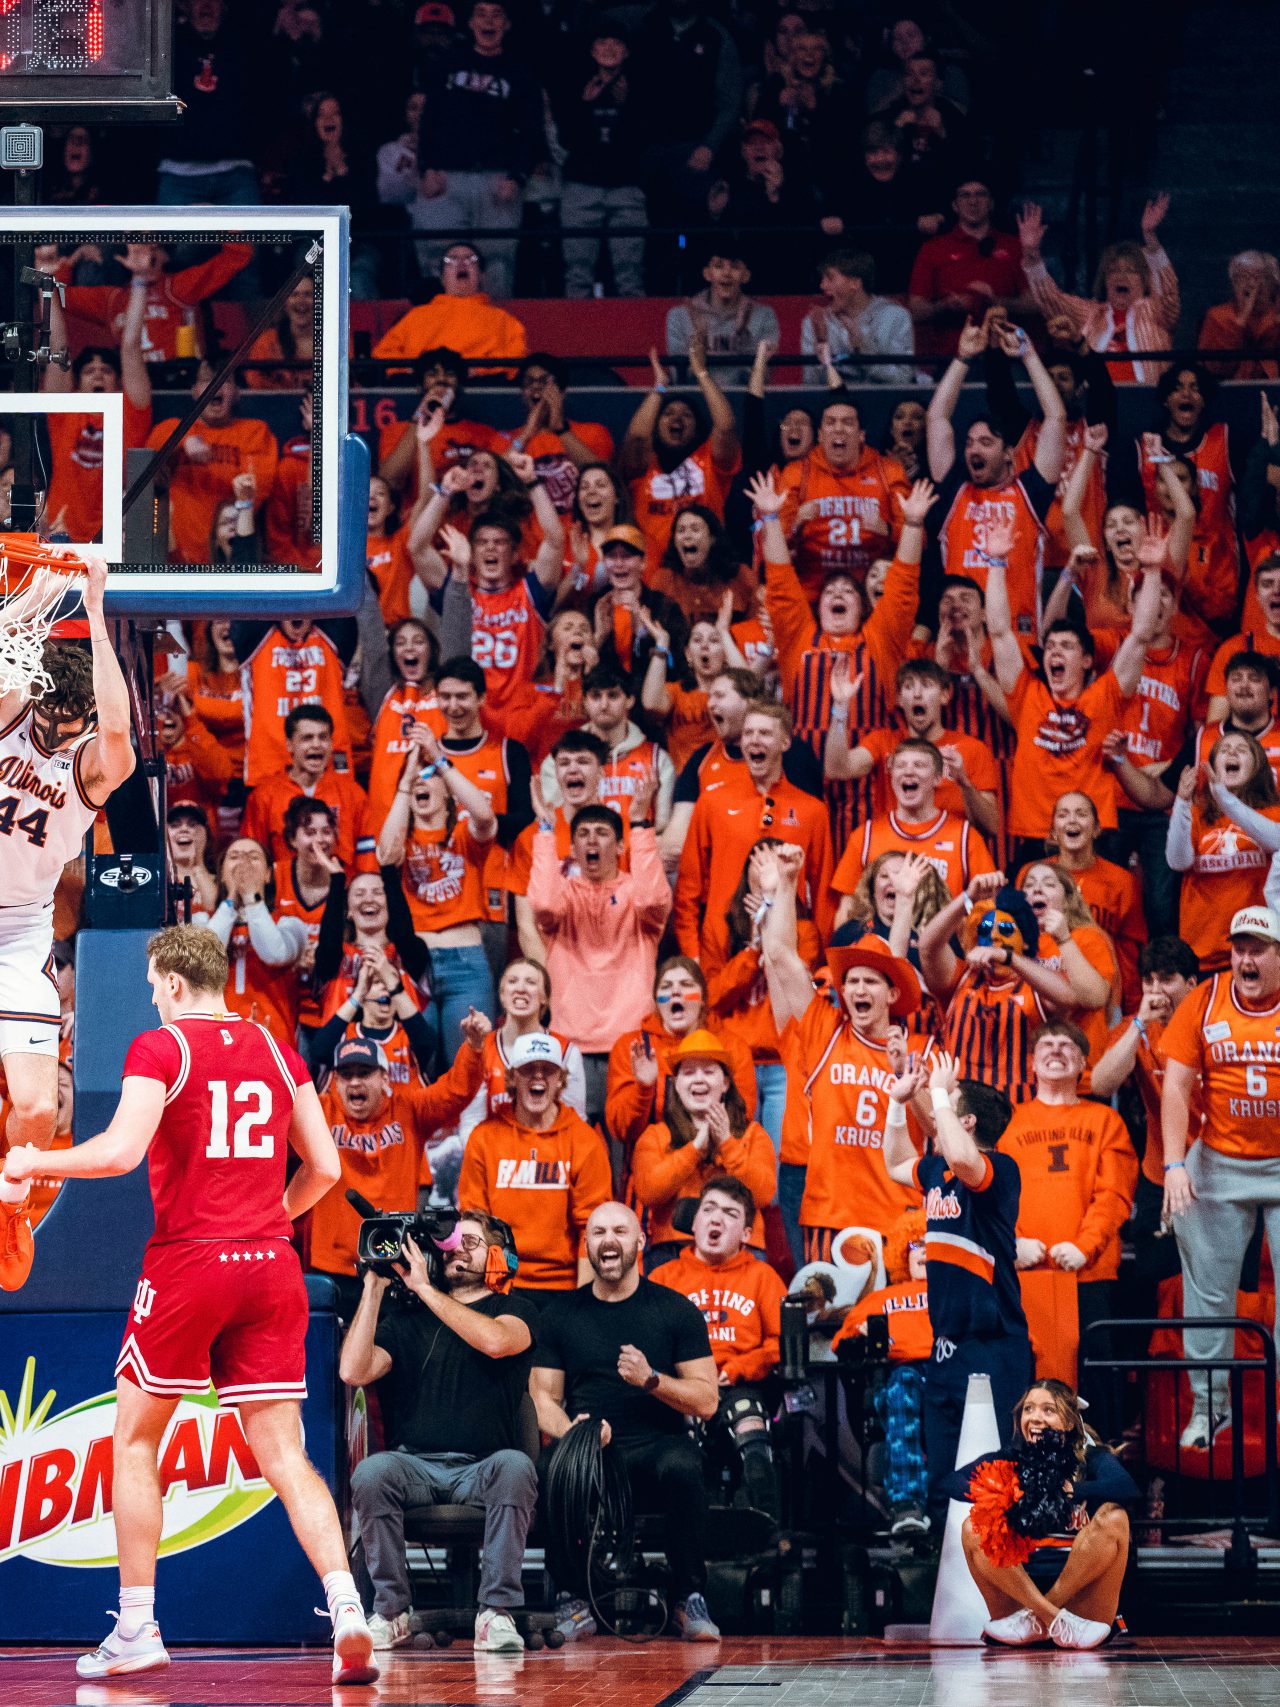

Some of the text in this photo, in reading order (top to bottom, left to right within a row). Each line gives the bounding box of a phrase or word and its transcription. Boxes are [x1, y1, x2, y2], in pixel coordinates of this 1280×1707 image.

[828, 518, 860, 546] 21
[472, 630, 518, 669] 26
[285, 669, 317, 693] 23
[1246, 1064, 1268, 1097] 6
[206, 1080, 275, 1159] 12
[856, 1089, 879, 1127] 6
